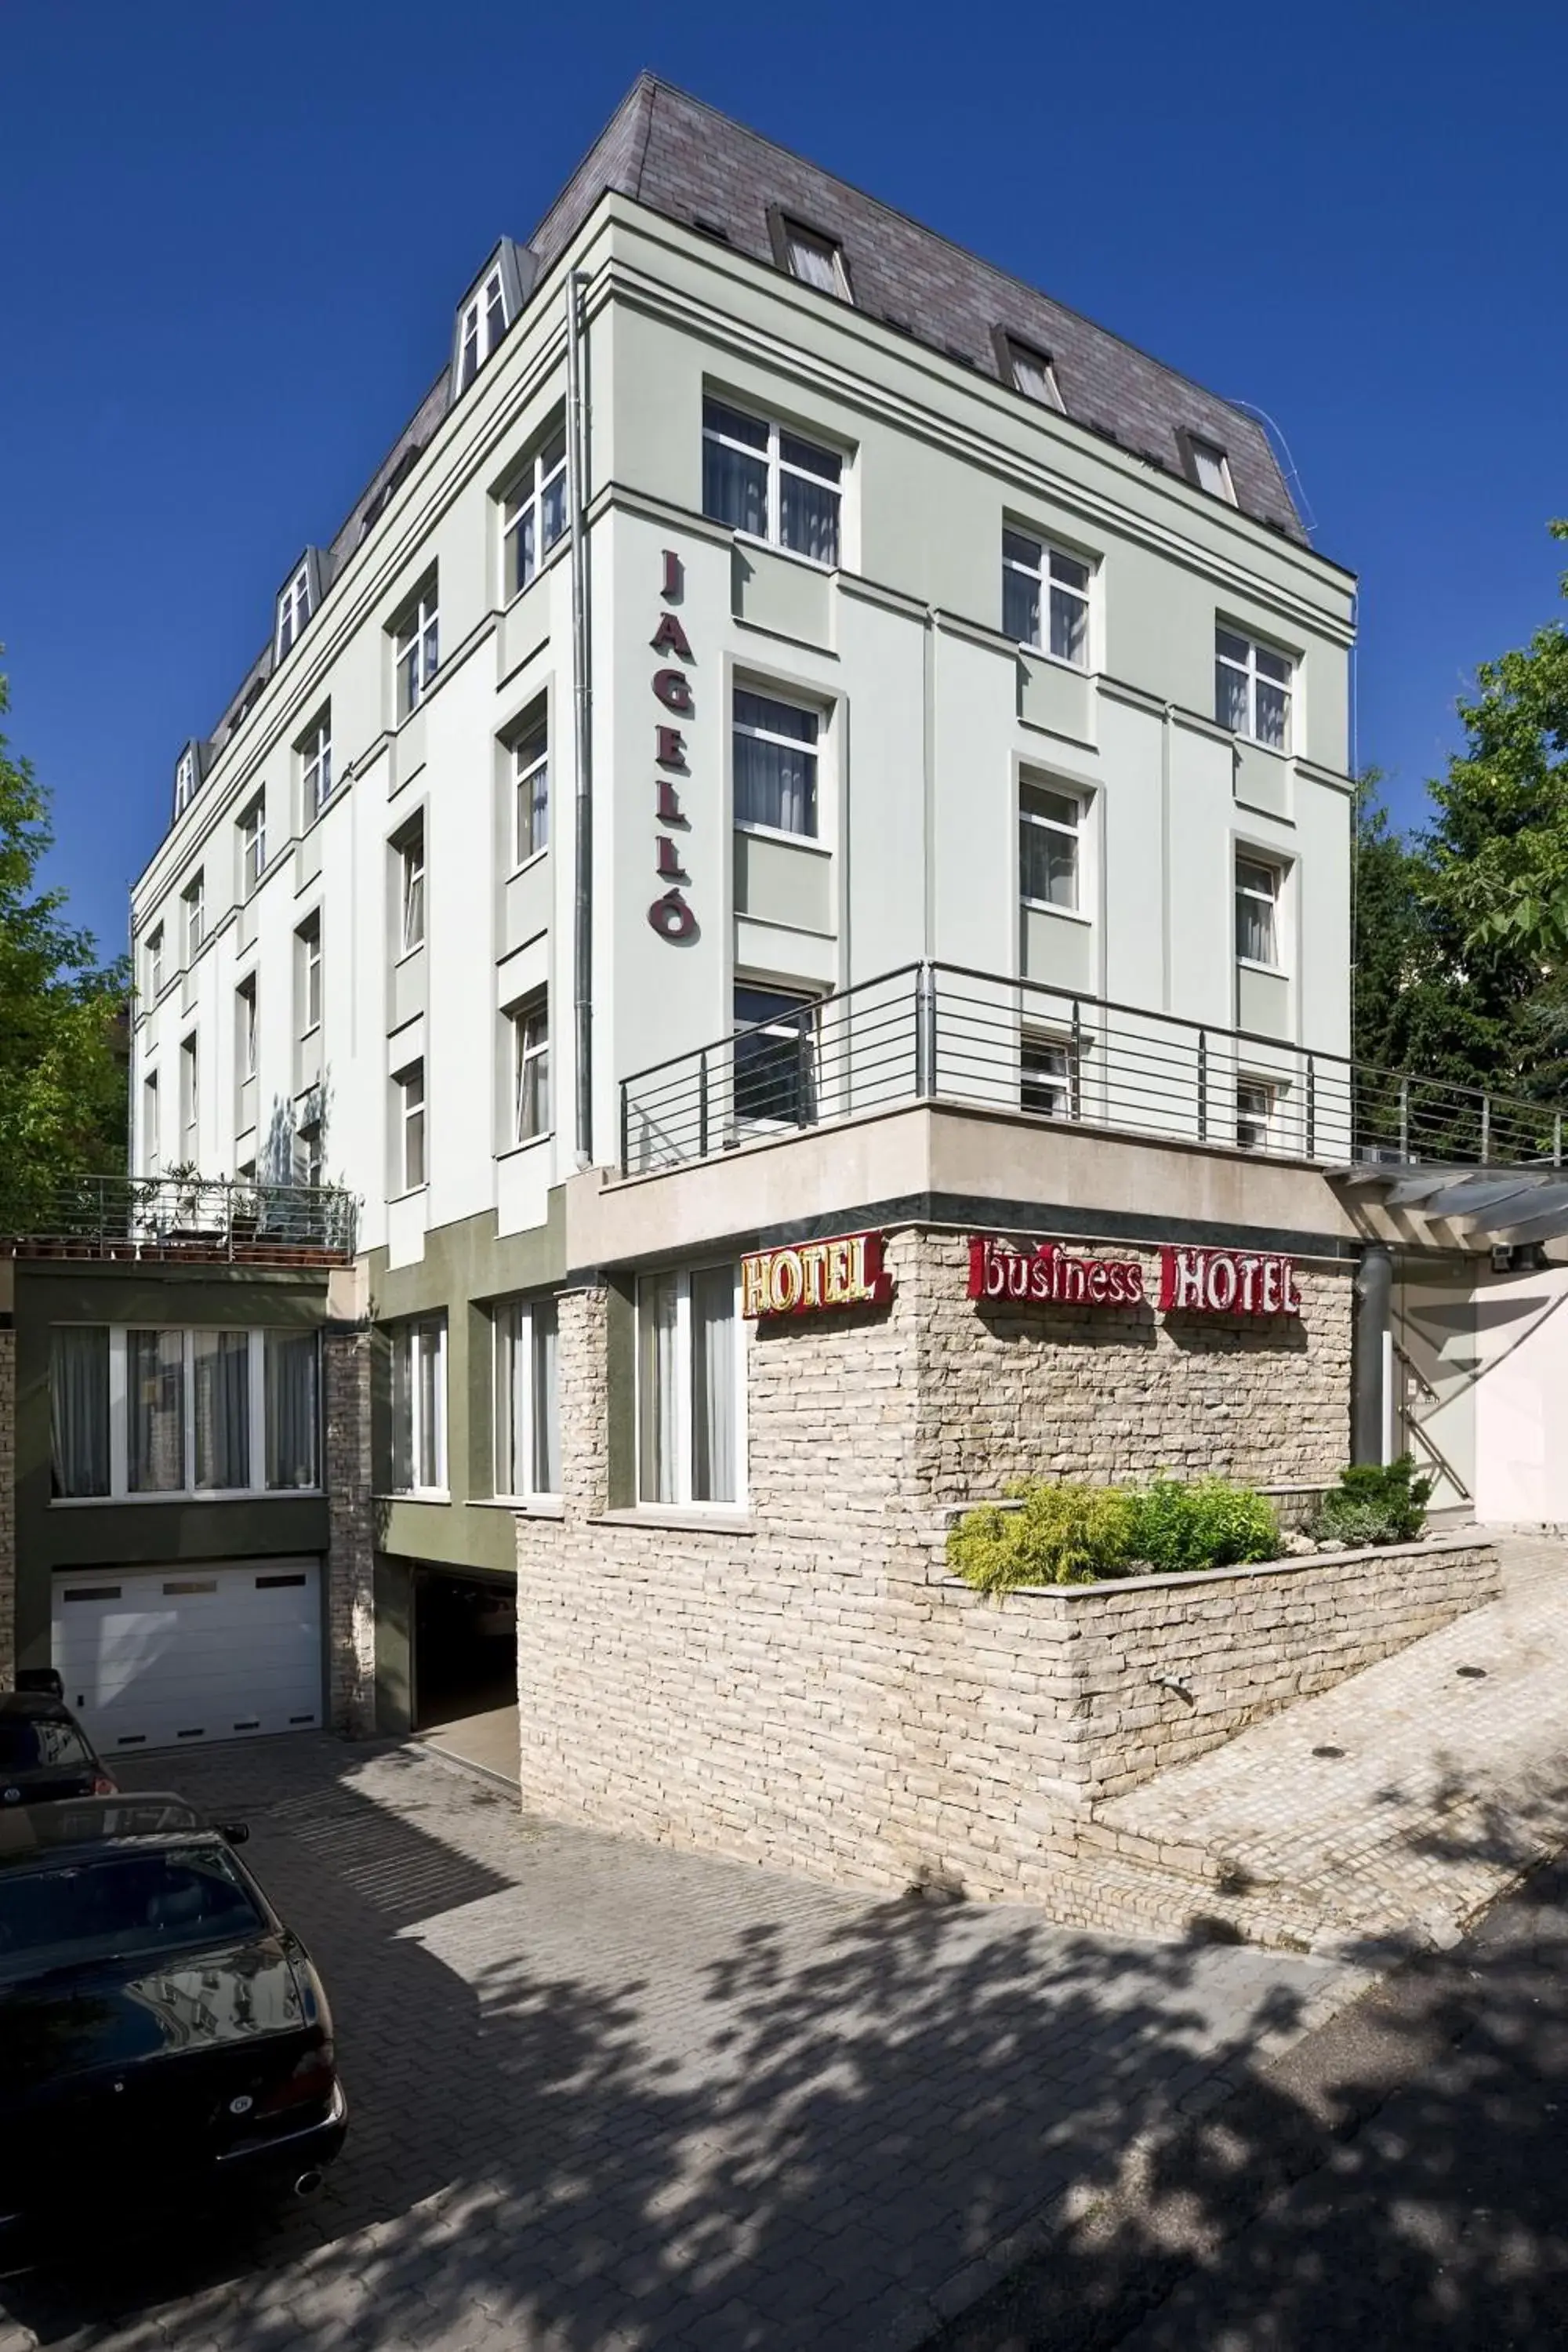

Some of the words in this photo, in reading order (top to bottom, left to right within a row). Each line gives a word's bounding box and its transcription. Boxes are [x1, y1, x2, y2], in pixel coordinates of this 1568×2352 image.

[742, 1236, 877, 1317] HOTEL
[982, 1241, 1144, 1303] business
[1174, 1251, 1300, 1312] HOTEL
